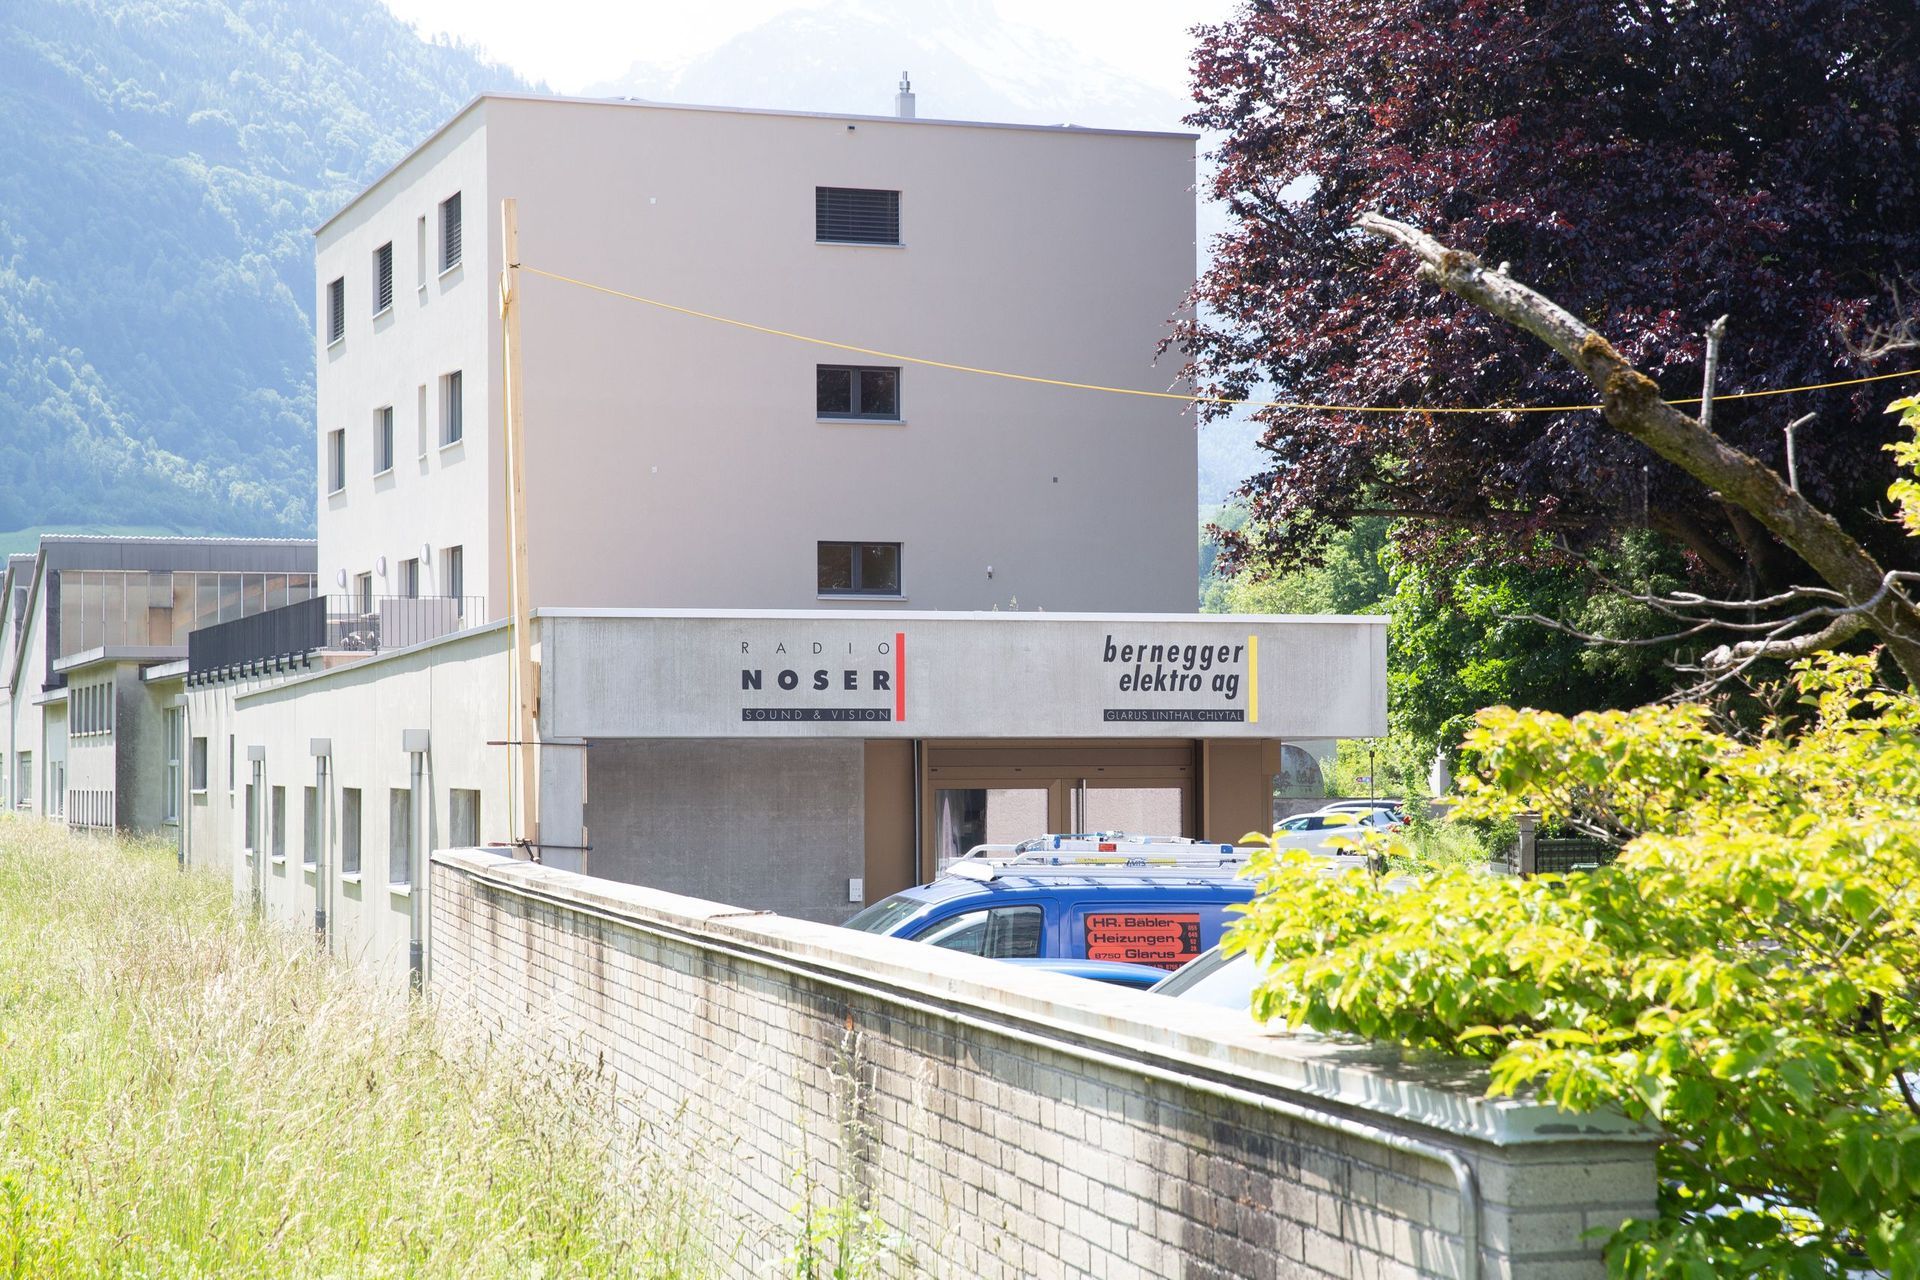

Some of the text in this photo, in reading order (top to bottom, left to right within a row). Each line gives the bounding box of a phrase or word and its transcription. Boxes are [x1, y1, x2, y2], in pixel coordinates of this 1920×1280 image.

[741, 642, 890, 654] RADIO
[1103, 635, 1244, 671] bernegger
[741, 669, 891, 690] NOSER
[1119, 664, 1239, 700] elektro ag
[745, 710, 888, 719] SOUND & VISION
[1106, 711, 1241, 720] GLARUS LINTHAL CHLYTAL
[1093, 918, 1174, 928] HR. Bäbler
[1094, 933, 1175, 945] Heizungen
[1125, 949, 1175, 959] Glarus
